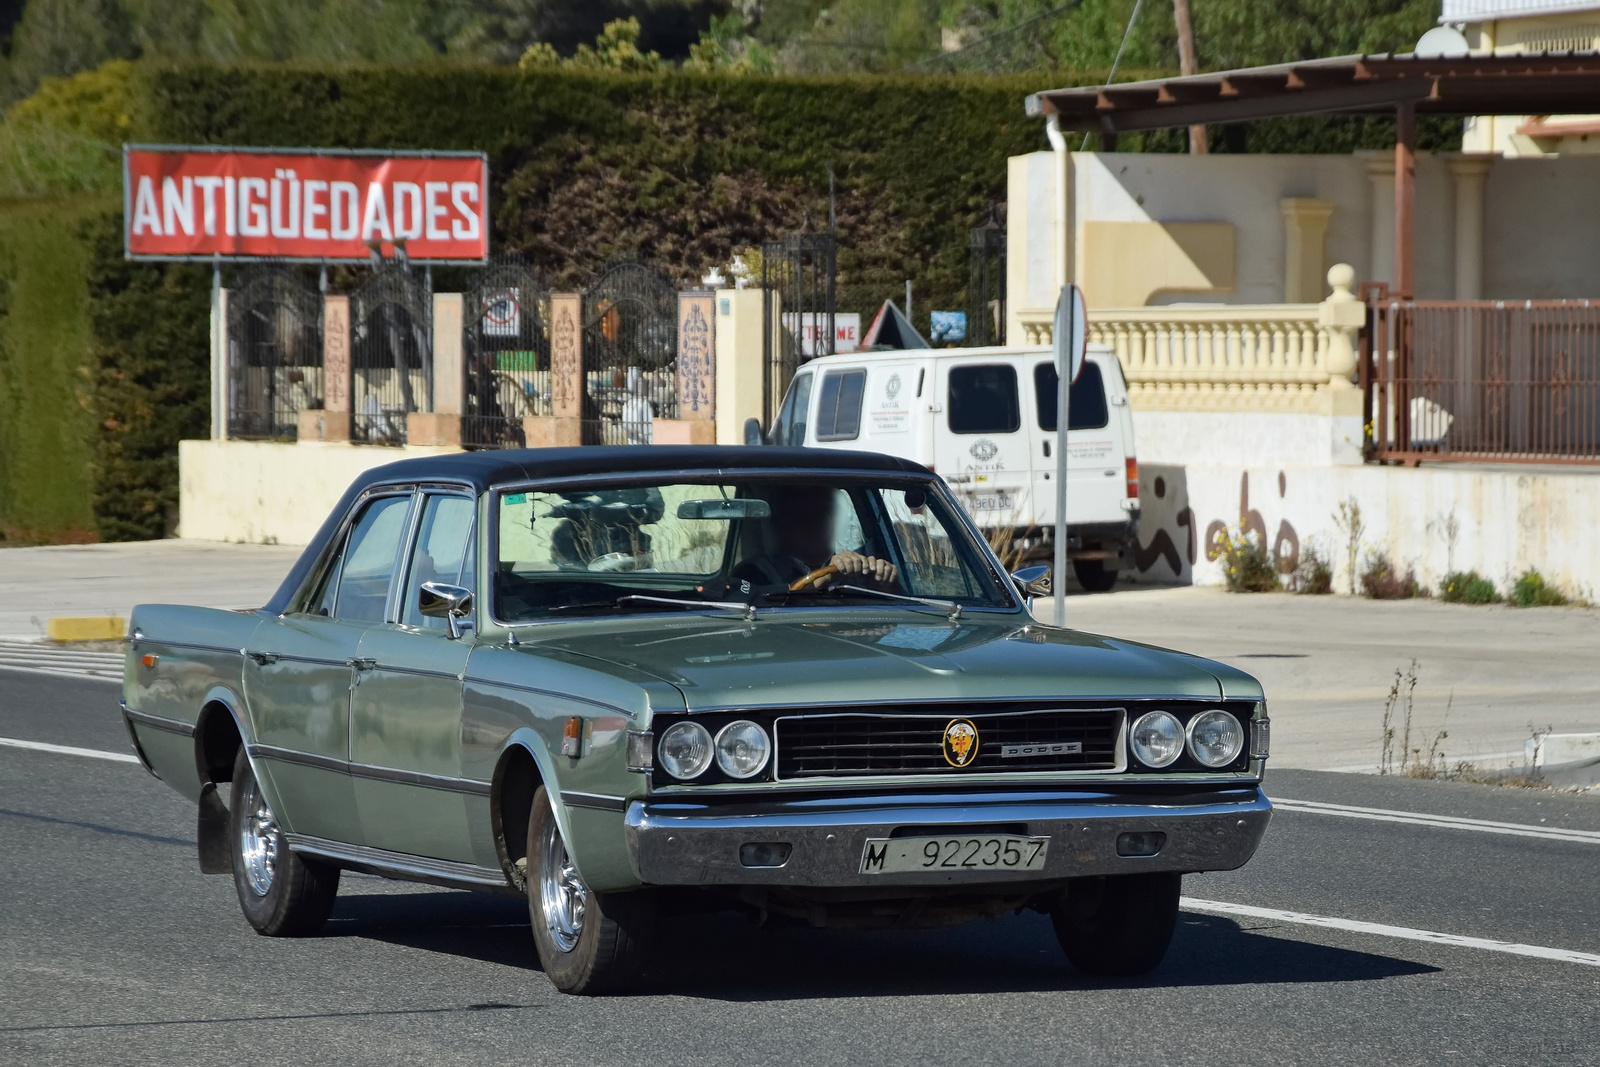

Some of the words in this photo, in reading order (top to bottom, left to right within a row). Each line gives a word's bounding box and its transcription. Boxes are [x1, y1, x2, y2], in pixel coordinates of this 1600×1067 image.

[132, 168, 480, 241] ANTIGÜEDADES
[1008, 745, 1078, 755] DODGE
[865, 843, 888, 870] M
[922, 839, 1045, 867] 922357
